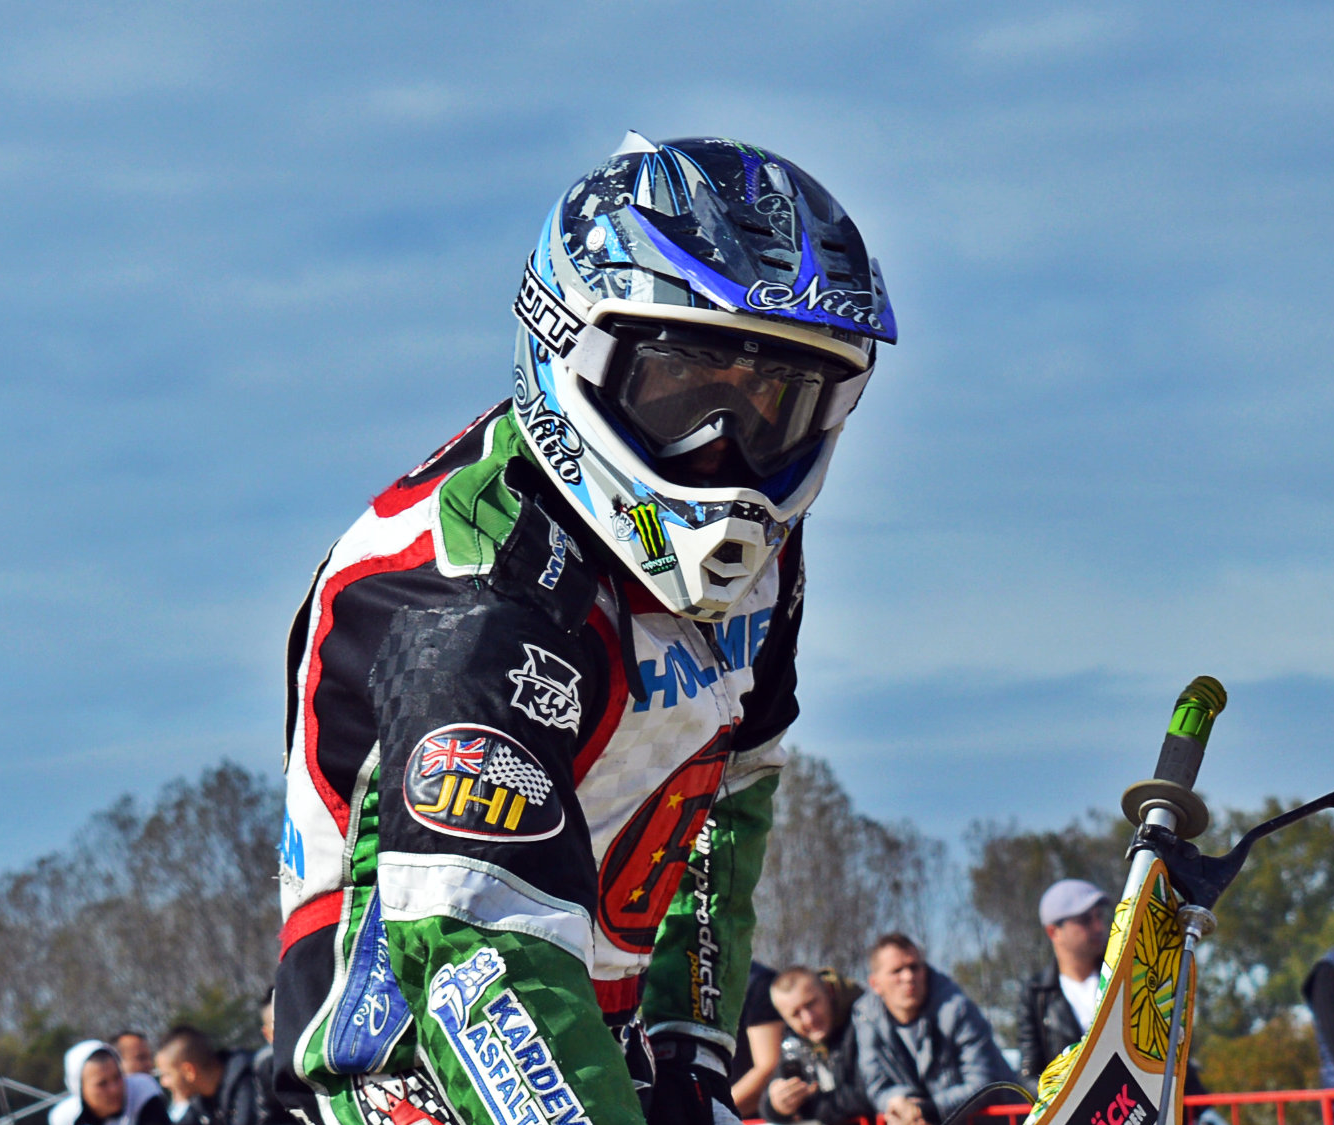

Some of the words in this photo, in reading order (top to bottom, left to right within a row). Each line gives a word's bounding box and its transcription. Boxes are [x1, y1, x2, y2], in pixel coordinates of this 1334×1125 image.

[517, 269, 584, 352] OTT
[746, 274, 883, 330] Nitro
[515, 367, 584, 485] Nitro
[415, 775, 527, 831] JHI
